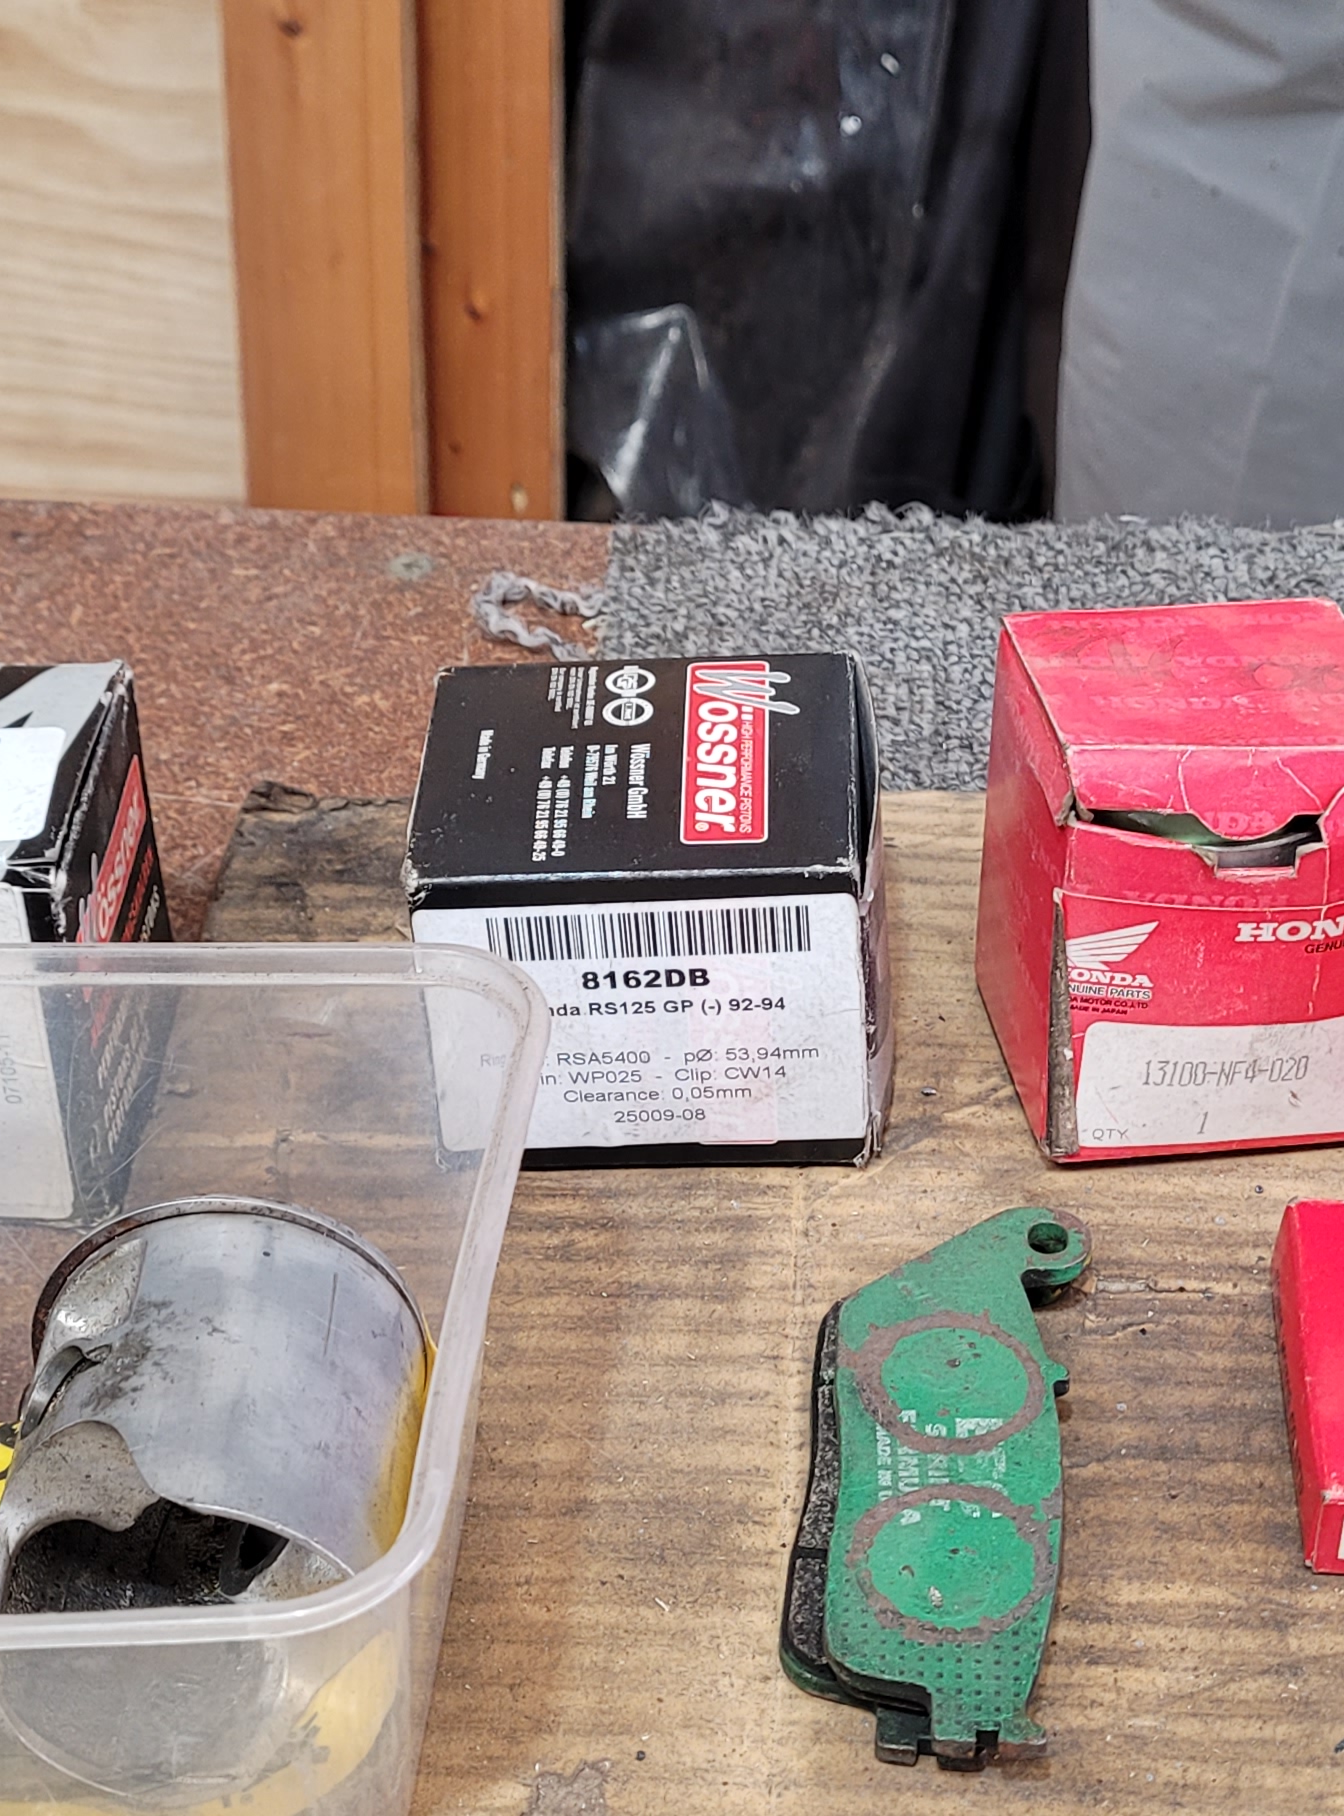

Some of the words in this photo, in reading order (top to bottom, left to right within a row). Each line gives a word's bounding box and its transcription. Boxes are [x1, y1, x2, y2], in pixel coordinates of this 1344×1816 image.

[629, 743, 651, 786] Wössner
[740, 739, 753, 796] PERFORMANCE
[626, 787, 649, 819] GmbH
[739, 797, 752, 833] PISTONS
[582, 968, 710, 990] 8162DB
[1068, 967, 1154, 987] ONDA
[1110, 988, 1150, 999] PARTS
[550, 1002, 581, 1017] nda
[588, 1001, 655, 1015] RS125
[663, 1000, 693, 1014] GP
[701, 999, 722, 1016] (-)
[728, 997, 786, 1012] 92-94
[557, 1050, 651, 1066] RSA5400
[540, 1072, 563, 1085] in:
[569, 1071, 642, 1084] WP025
[674, 1068, 717, 1084] Clip:
[724, 1066, 787, 1081] CW14
[1142, 1055, 1309, 1088] 13100-NF4-020
[563, 1088, 664, 1103] Clearance:
[671, 1086, 752, 1102] 0,05mm
[614, 1108, 706, 1123] 25009-08
[1197, 1111, 1208, 1135] 1
[1092, 1127, 1128, 1140] QTY
